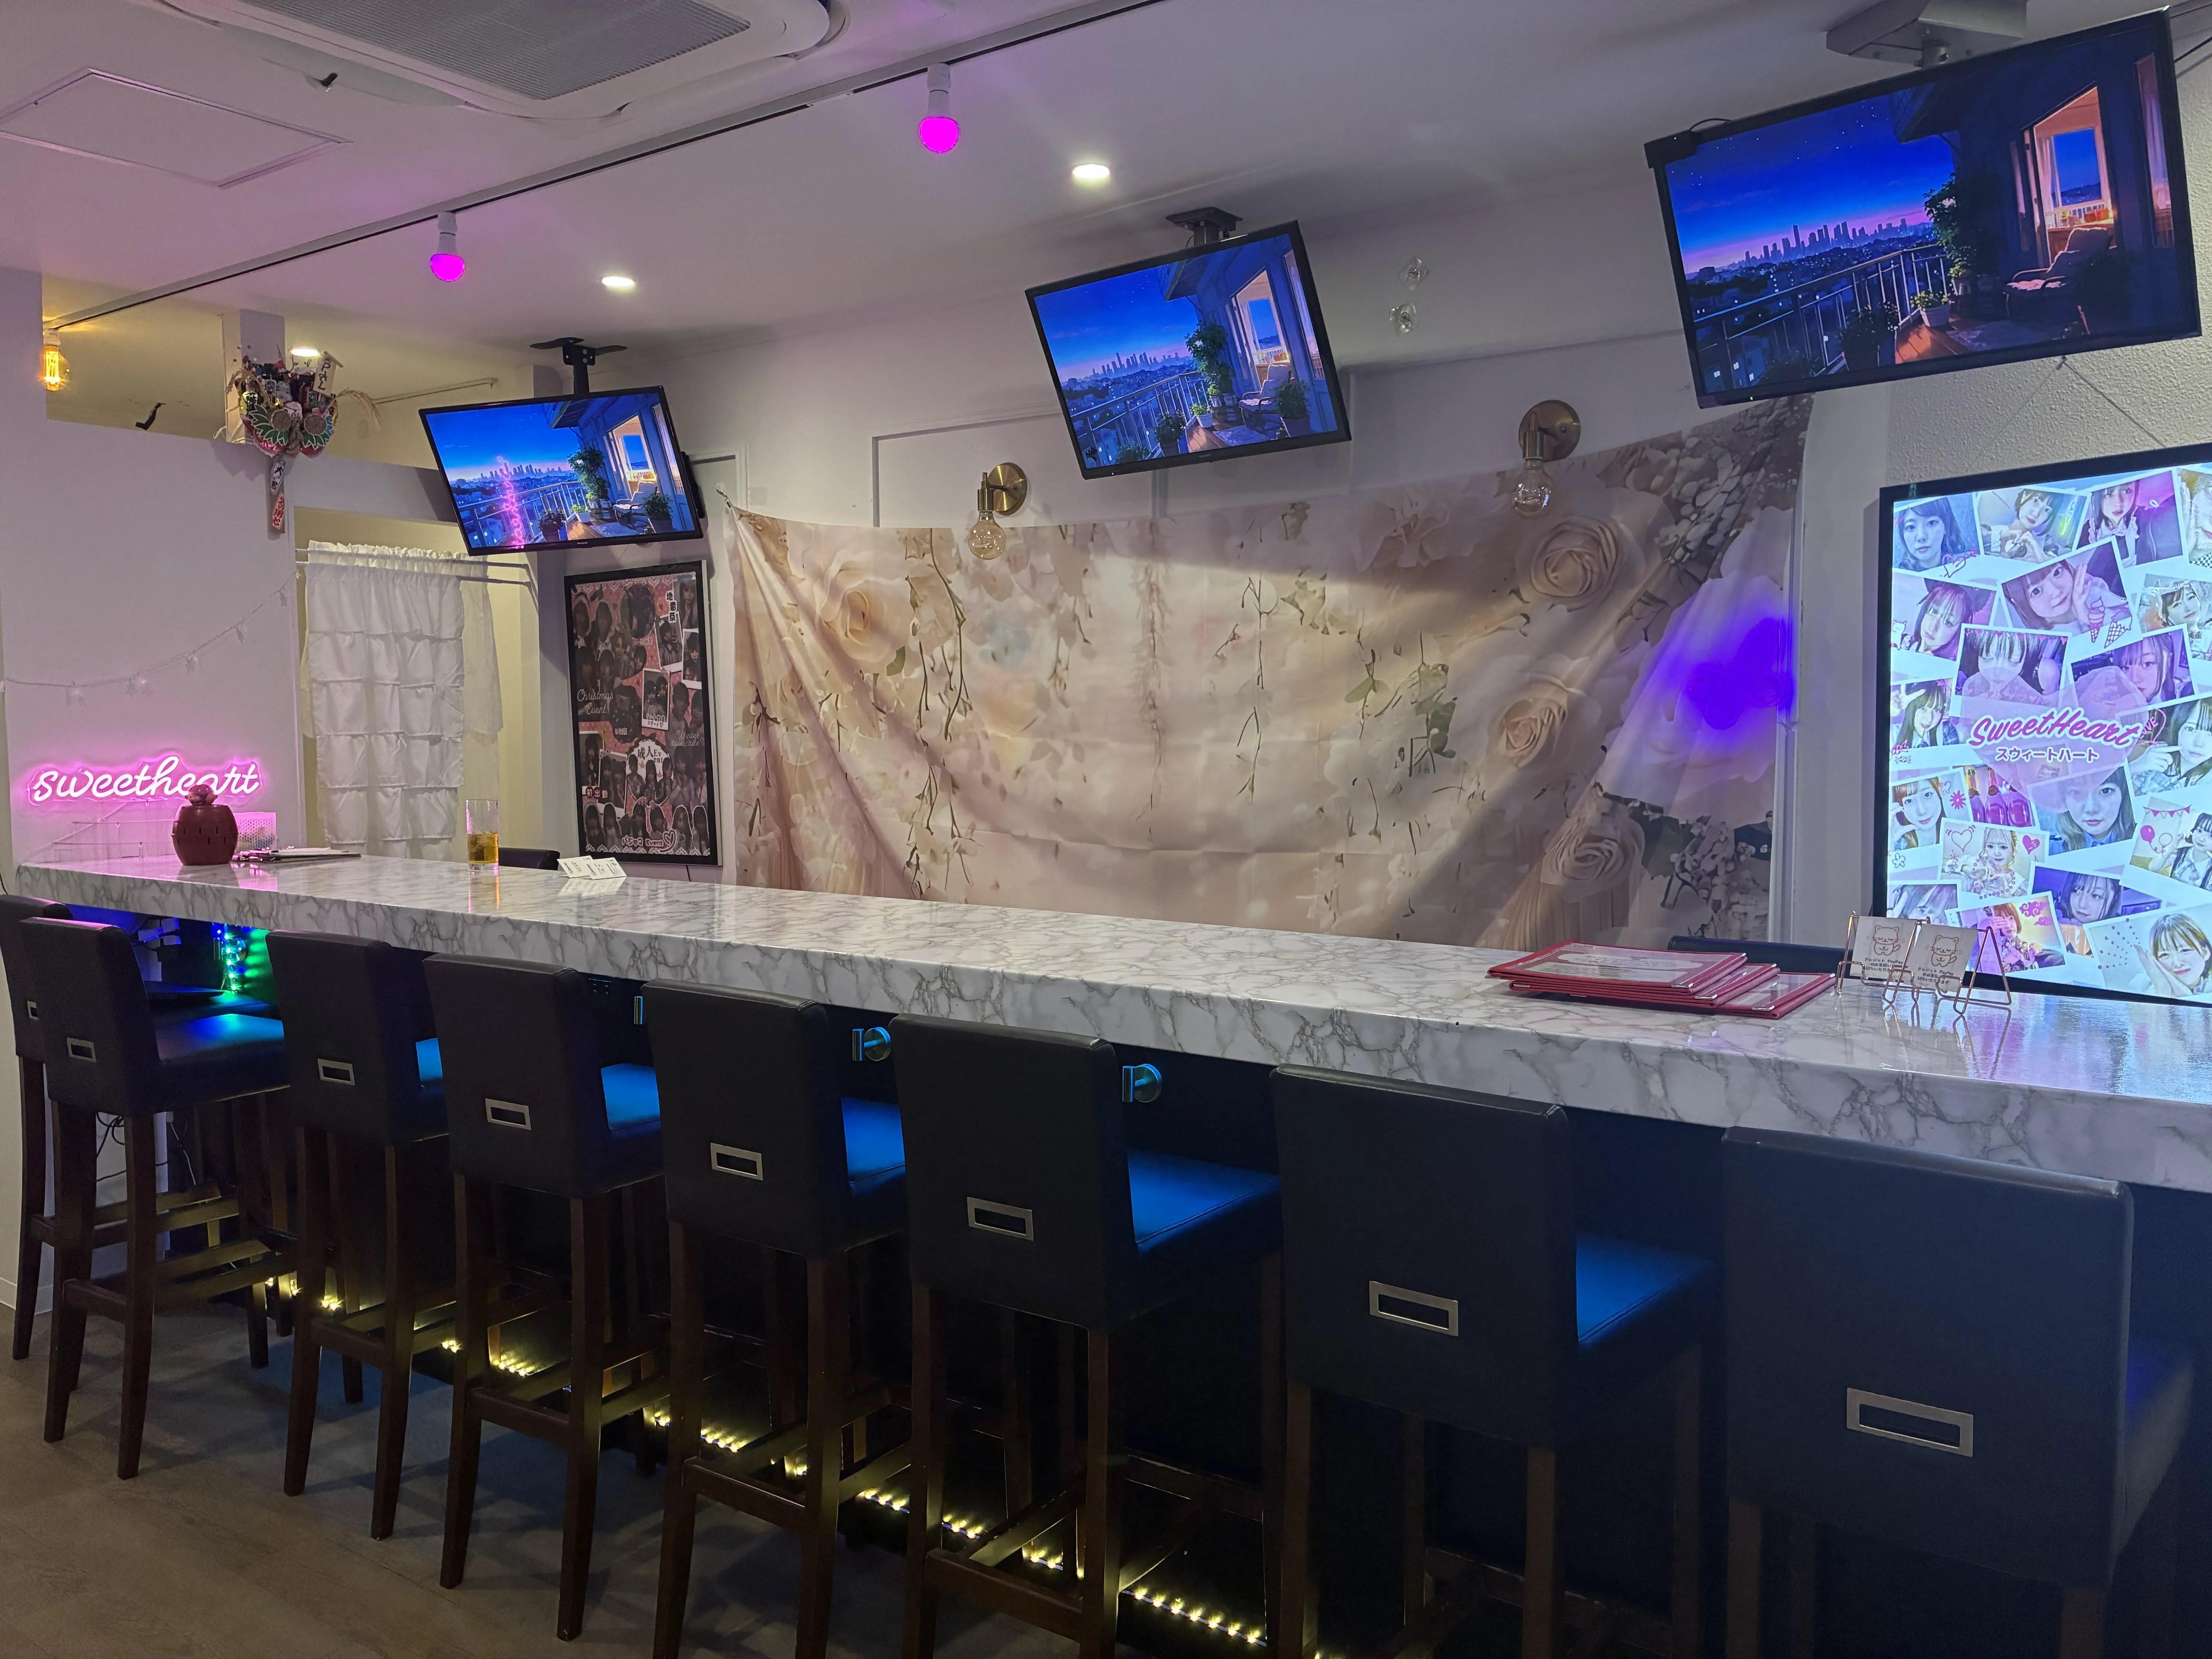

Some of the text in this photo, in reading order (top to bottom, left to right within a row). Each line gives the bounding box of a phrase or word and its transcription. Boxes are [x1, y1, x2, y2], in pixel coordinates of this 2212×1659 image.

[577, 689, 613, 701] Christmas
[586, 701, 606, 714] Event
[1968, 709, 2140, 746] SweetHeart
[1996, 748, 2099, 762] スウィートハート
